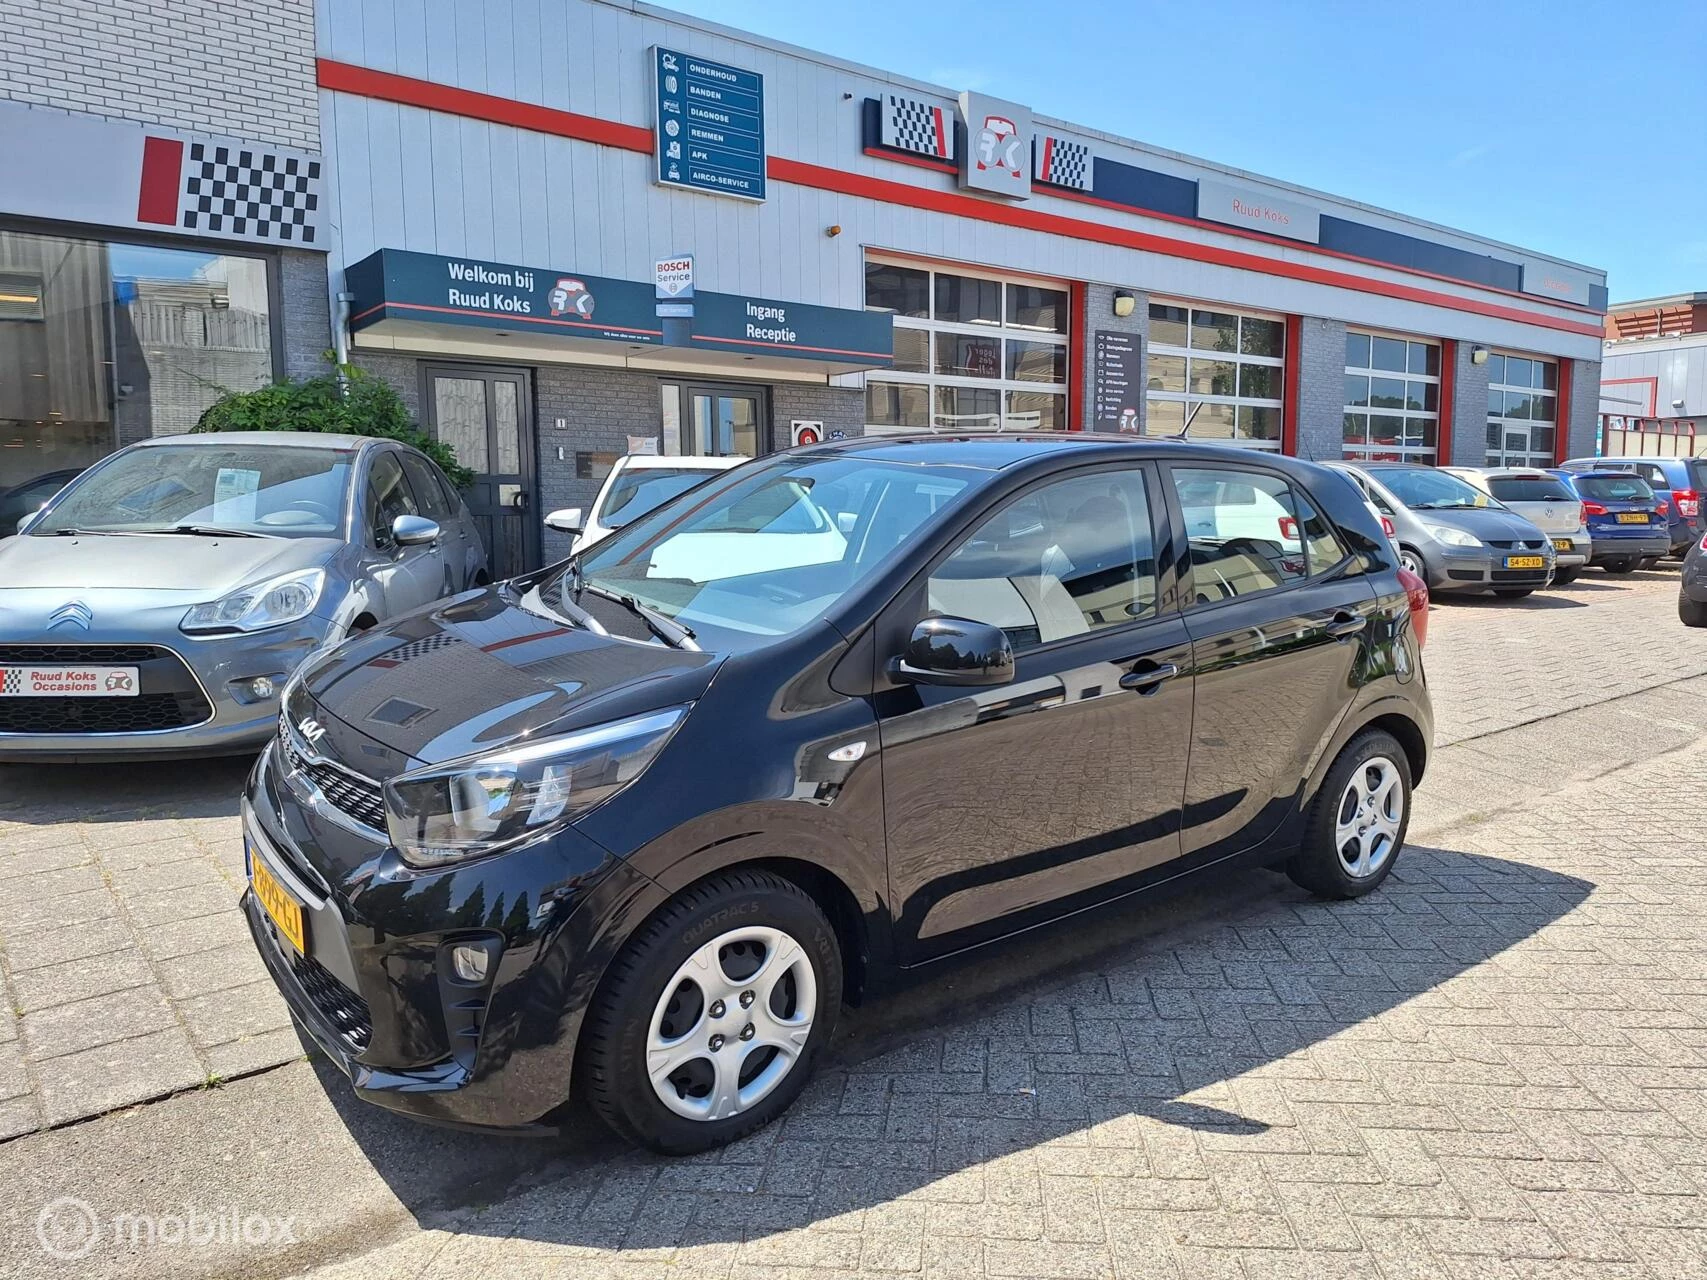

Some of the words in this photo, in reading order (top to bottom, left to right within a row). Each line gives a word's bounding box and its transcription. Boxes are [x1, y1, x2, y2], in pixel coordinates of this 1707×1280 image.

[690, 64, 737, 82] ONDERHOUD
[690, 86, 721, 100] BANDEN
[691, 109, 730, 123] DIAGNOSE
[691, 129, 724, 142] REMMEN
[692, 151, 708, 160] APK
[693, 172, 749, 188] AIRCO-SERVICE
[1233, 199, 1260, 218] Ruud
[657, 261, 690, 272] BOSCH
[448, 262, 512, 287] Welkom
[515, 270, 534, 292] bij
[657, 273, 690, 282] Service
[448, 288, 490, 309] Ruud
[493, 294, 531, 313] Koks
[746, 301, 785, 323] Ingang
[746, 323, 796, 343] Receptie
[30, 671, 62, 681] Ruud
[65, 671, 97, 681] Koks
[33, 681, 97, 691] Occasions
[682, 902, 747, 945] QUATRAC
[751, 901, 760, 913] 5
